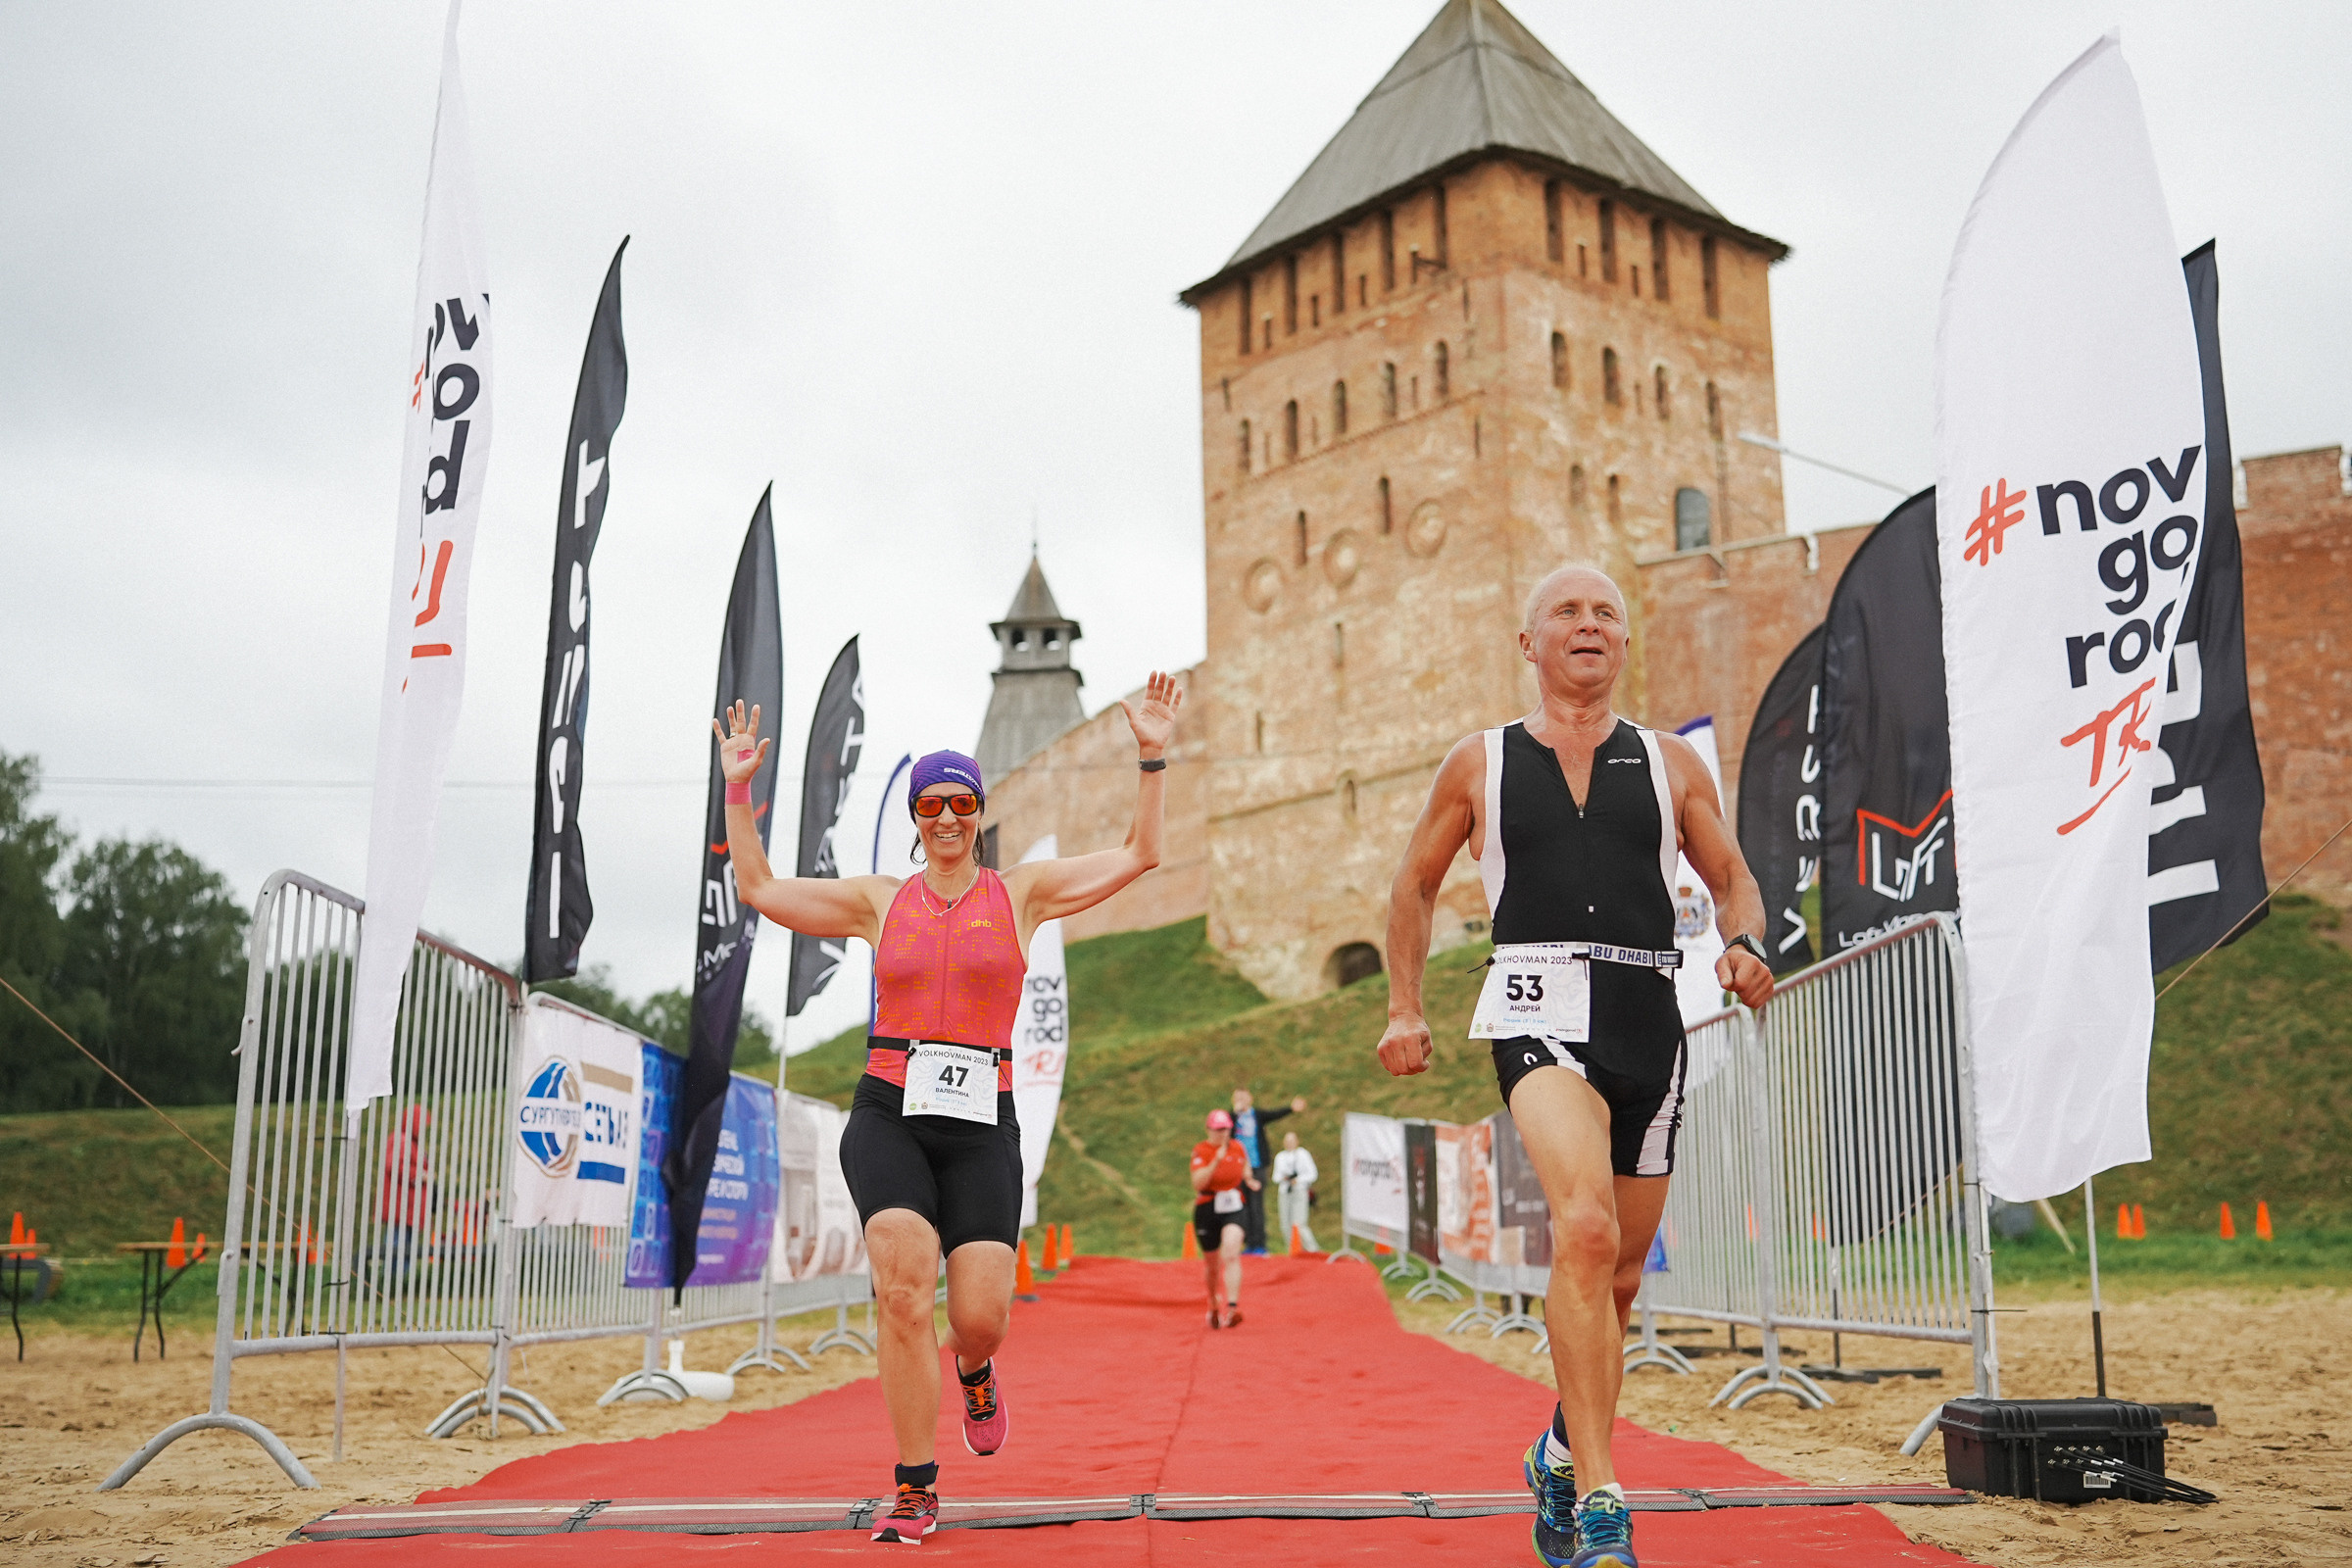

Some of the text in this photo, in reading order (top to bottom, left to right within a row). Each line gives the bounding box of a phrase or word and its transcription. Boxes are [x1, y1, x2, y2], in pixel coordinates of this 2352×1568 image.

[1964, 444, 2202, 566] #nov
[2097, 514, 2198, 615] go
[970, 919, 992, 928] dhb
[1550, 956, 1573, 965] 2023
[1617, 949, 1651, 964] DHABI
[1506, 974, 1544, 1002] 53
[1509, 1004, 1542, 1013] АНДРЕЙ
[918, 1050, 989, 1065] VOLKHOVMAN 2023
[939, 1064, 969, 1088] 47
[935, 1087, 970, 1098] ВАЛЕНТИНА
